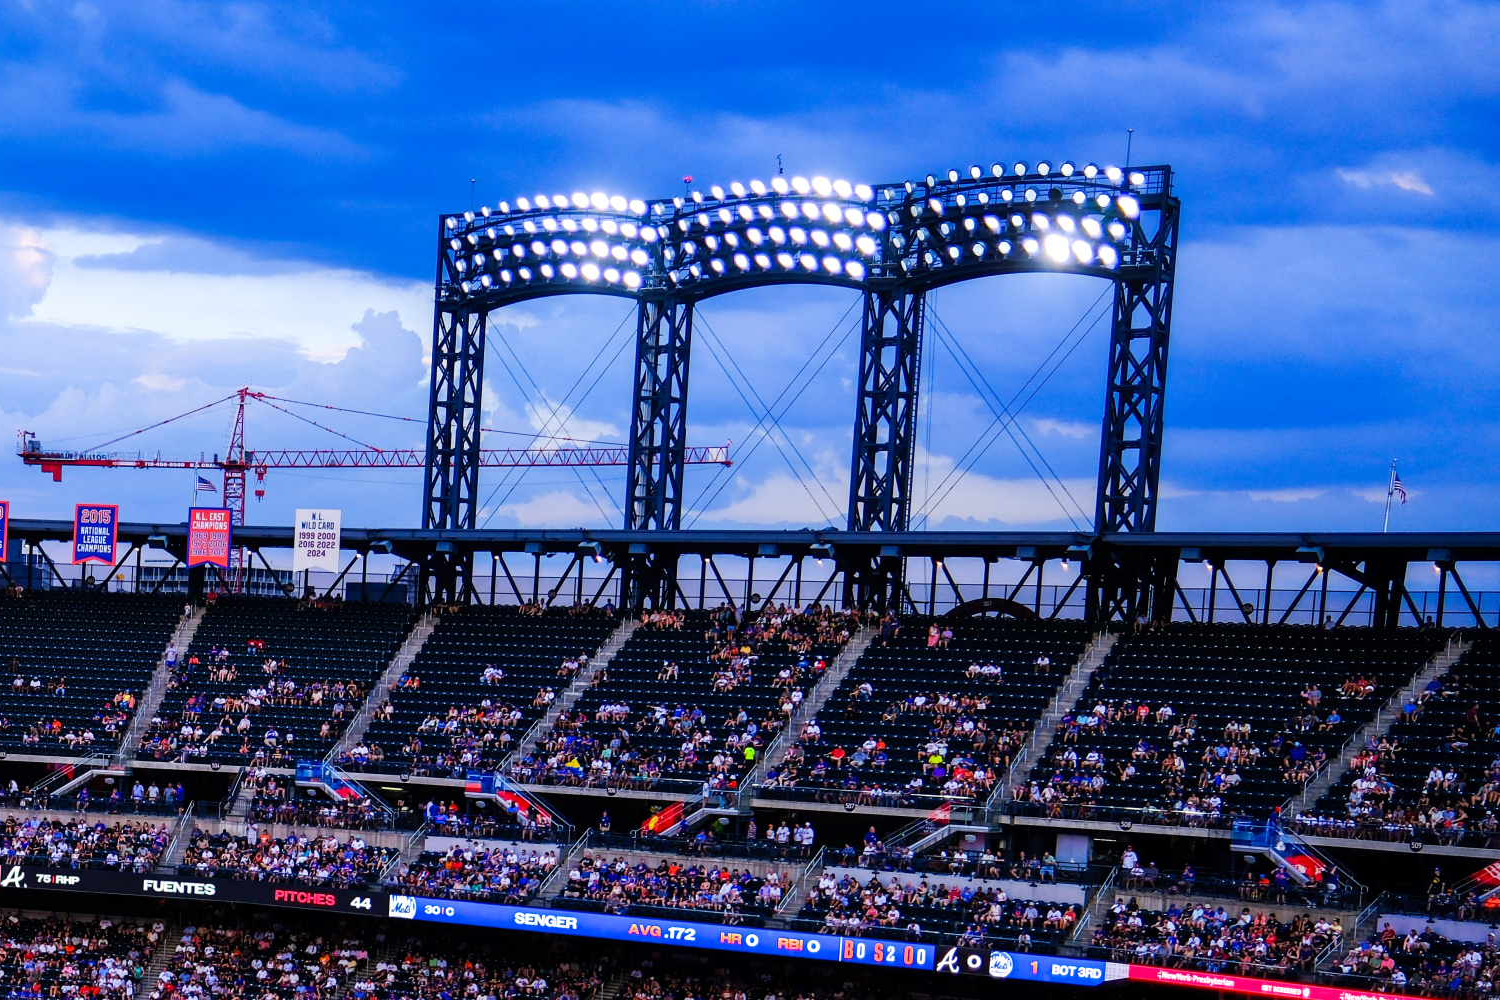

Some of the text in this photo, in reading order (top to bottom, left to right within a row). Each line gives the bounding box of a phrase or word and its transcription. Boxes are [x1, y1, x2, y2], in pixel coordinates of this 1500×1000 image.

[81, 509, 111, 524] 2015
[196, 512, 225, 522] N.L. EAST
[192, 520, 228, 530] CHAMPIONS
[301, 521, 335, 530] WILD CARD
[80, 526, 110, 536] NATIONAL
[82, 535, 106, 544] LEAGUE
[298, 532, 336, 541] 1999 2000
[77, 543, 112, 554] CHAMPIONS
[208, 541, 227, 549] 2006
[298, 540, 336, 550] 2016 2022
[208, 549, 226, 557] 2015
[306, 549, 326, 558] 2024
[36, 874, 215, 895] 75 RHP FUENTES
[275, 890, 371, 909] PITCHES 44
[425, 905, 577, 929] 30 C SENGER
[628, 924, 820, 952] AVG .172 HR 0 RBI 0
[844, 940, 854, 959] B
[857, 943, 865, 958] 0
[874, 943, 884, 962] S
[886, 946, 895, 961] 2
[917, 949, 925, 964] 0
[967, 955, 981, 968] 0
[1031, 961, 1101, 978] 1 BOT 3RD
[1160, 971, 1234, 986] NewYork-Presbyterian
[1274, 986, 1301, 995] SCREENED
